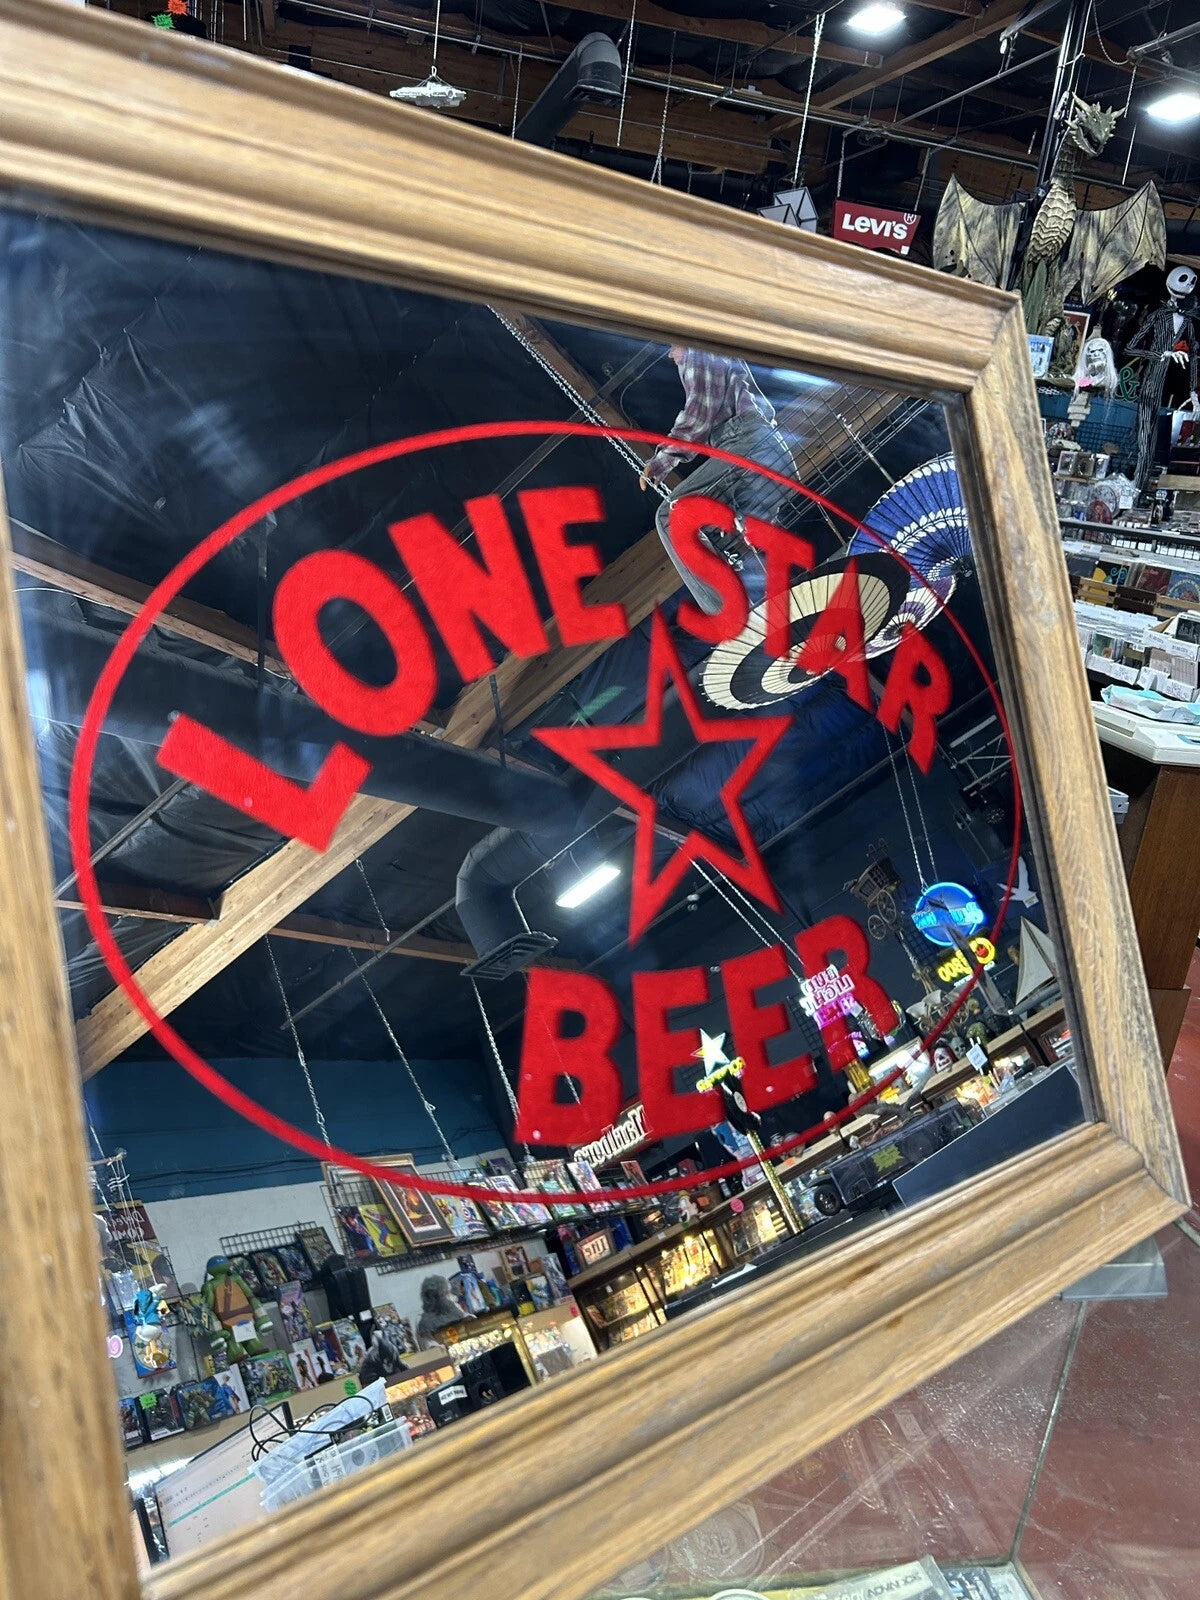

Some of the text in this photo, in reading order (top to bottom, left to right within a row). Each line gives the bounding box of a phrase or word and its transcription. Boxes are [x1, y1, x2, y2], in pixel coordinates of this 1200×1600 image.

[156, 485, 952, 854] LONE STAR
[514, 914, 898, 1147] BEER
